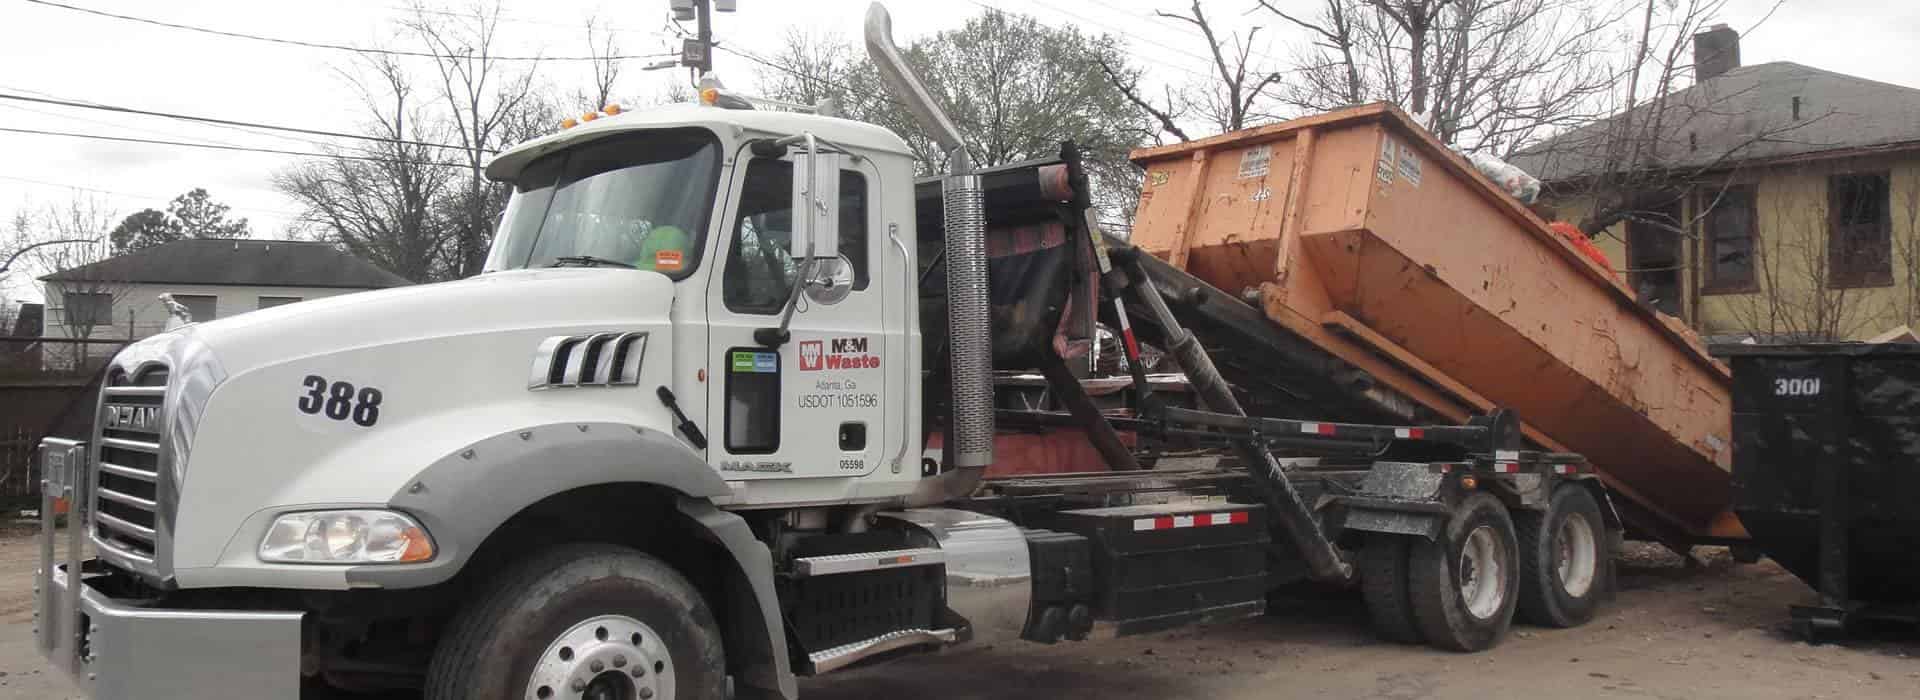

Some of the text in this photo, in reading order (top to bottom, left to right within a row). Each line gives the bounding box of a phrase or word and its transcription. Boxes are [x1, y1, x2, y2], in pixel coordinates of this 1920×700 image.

[831, 337, 868, 353] M&M
[826, 354, 880, 370] Waste
[299, 375, 382, 427] 388
[799, 393, 878, 408] USDOT 1051596
